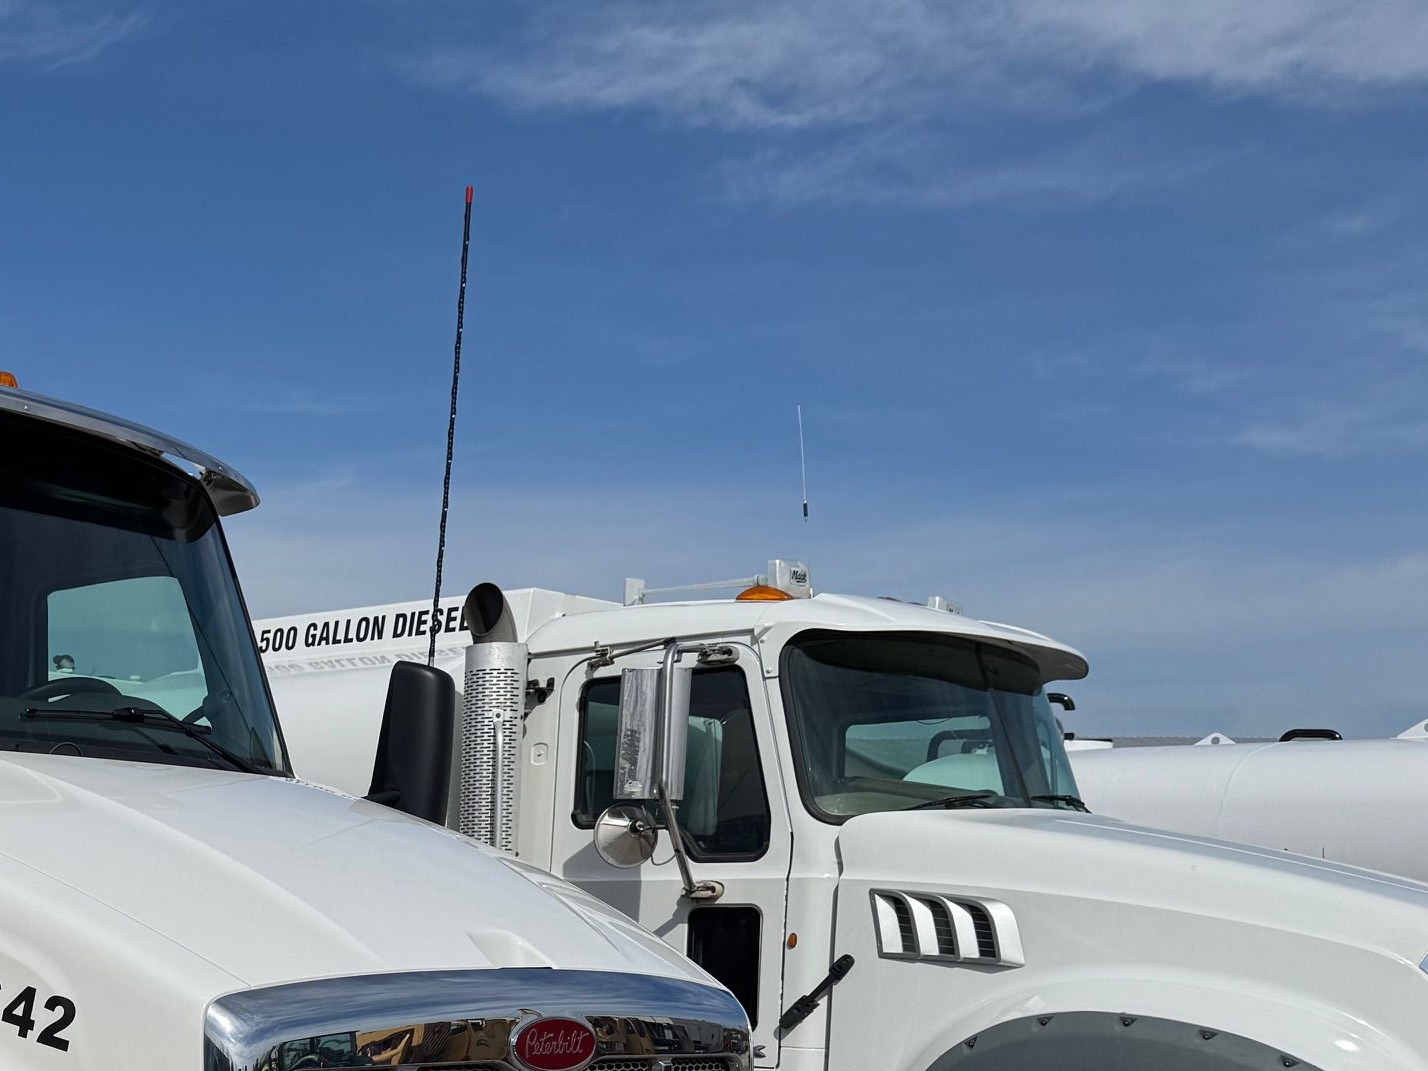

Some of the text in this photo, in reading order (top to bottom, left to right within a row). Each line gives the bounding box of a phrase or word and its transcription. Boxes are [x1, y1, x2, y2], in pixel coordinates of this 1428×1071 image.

[304, 615, 387, 647] GALLON
[392, 606, 470, 639] DIESEL
[525, 1028, 589, 1059] Peterbilt
